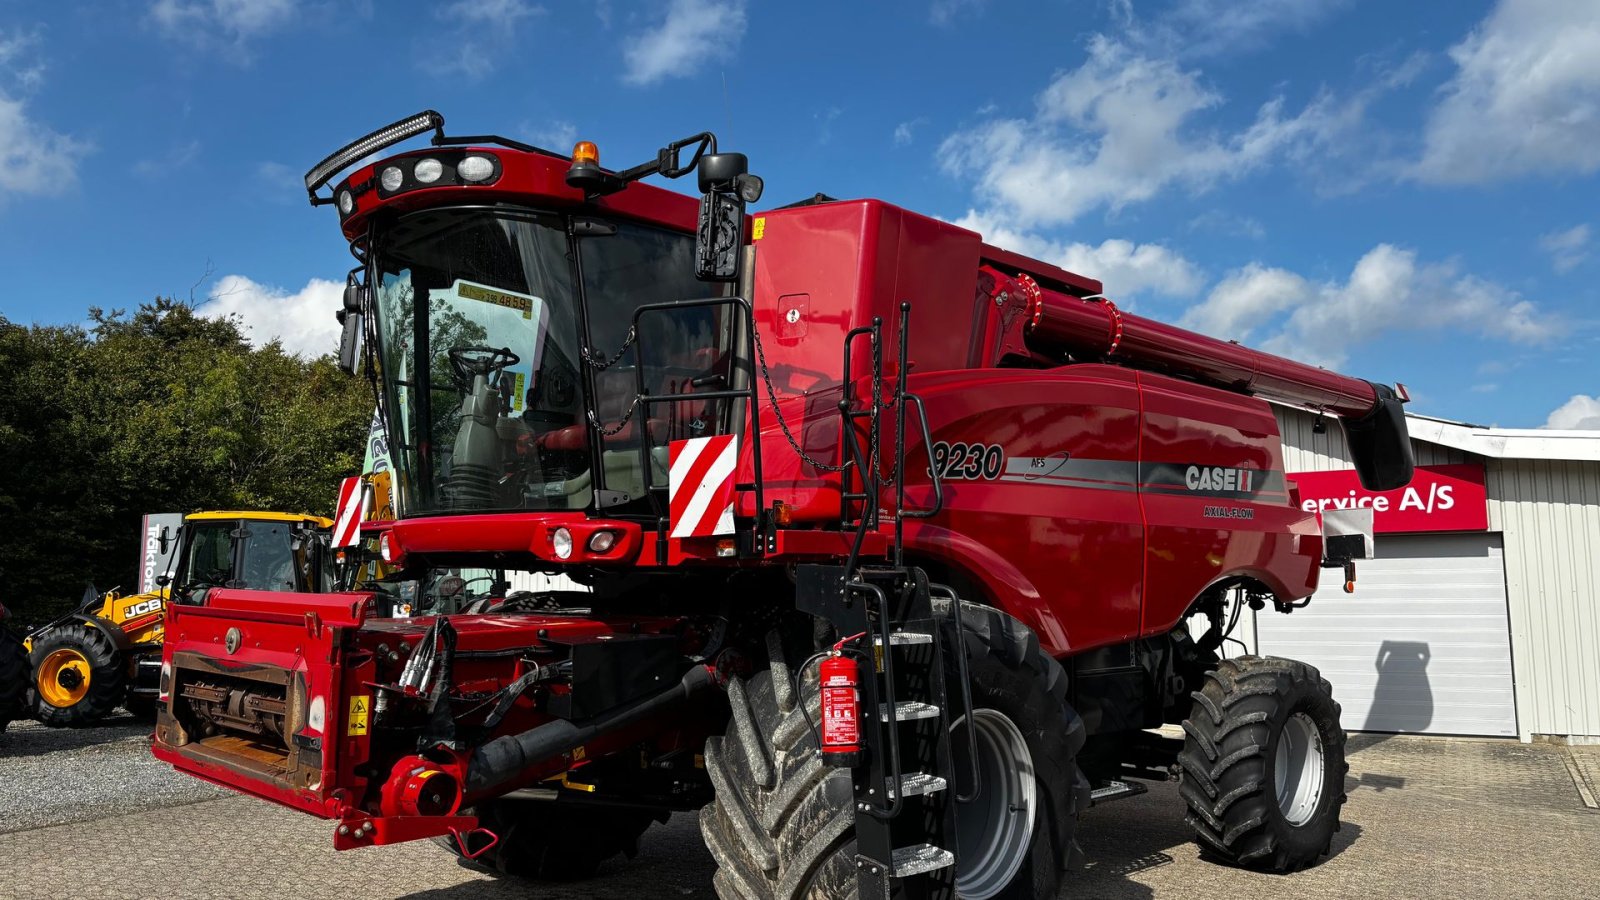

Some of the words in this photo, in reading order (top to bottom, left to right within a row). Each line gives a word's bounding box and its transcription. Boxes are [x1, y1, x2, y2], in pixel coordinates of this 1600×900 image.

[927, 441, 1003, 480] 9230
[1031, 458, 1045, 468] AFS
[1185, 465, 1235, 491] CASE
[1302, 490, 1389, 514] ervice
[1399, 483, 1454, 513] A/S
[1204, 505, 1254, 520] AXIAL-FLOW
[125, 598, 162, 618] JCB
